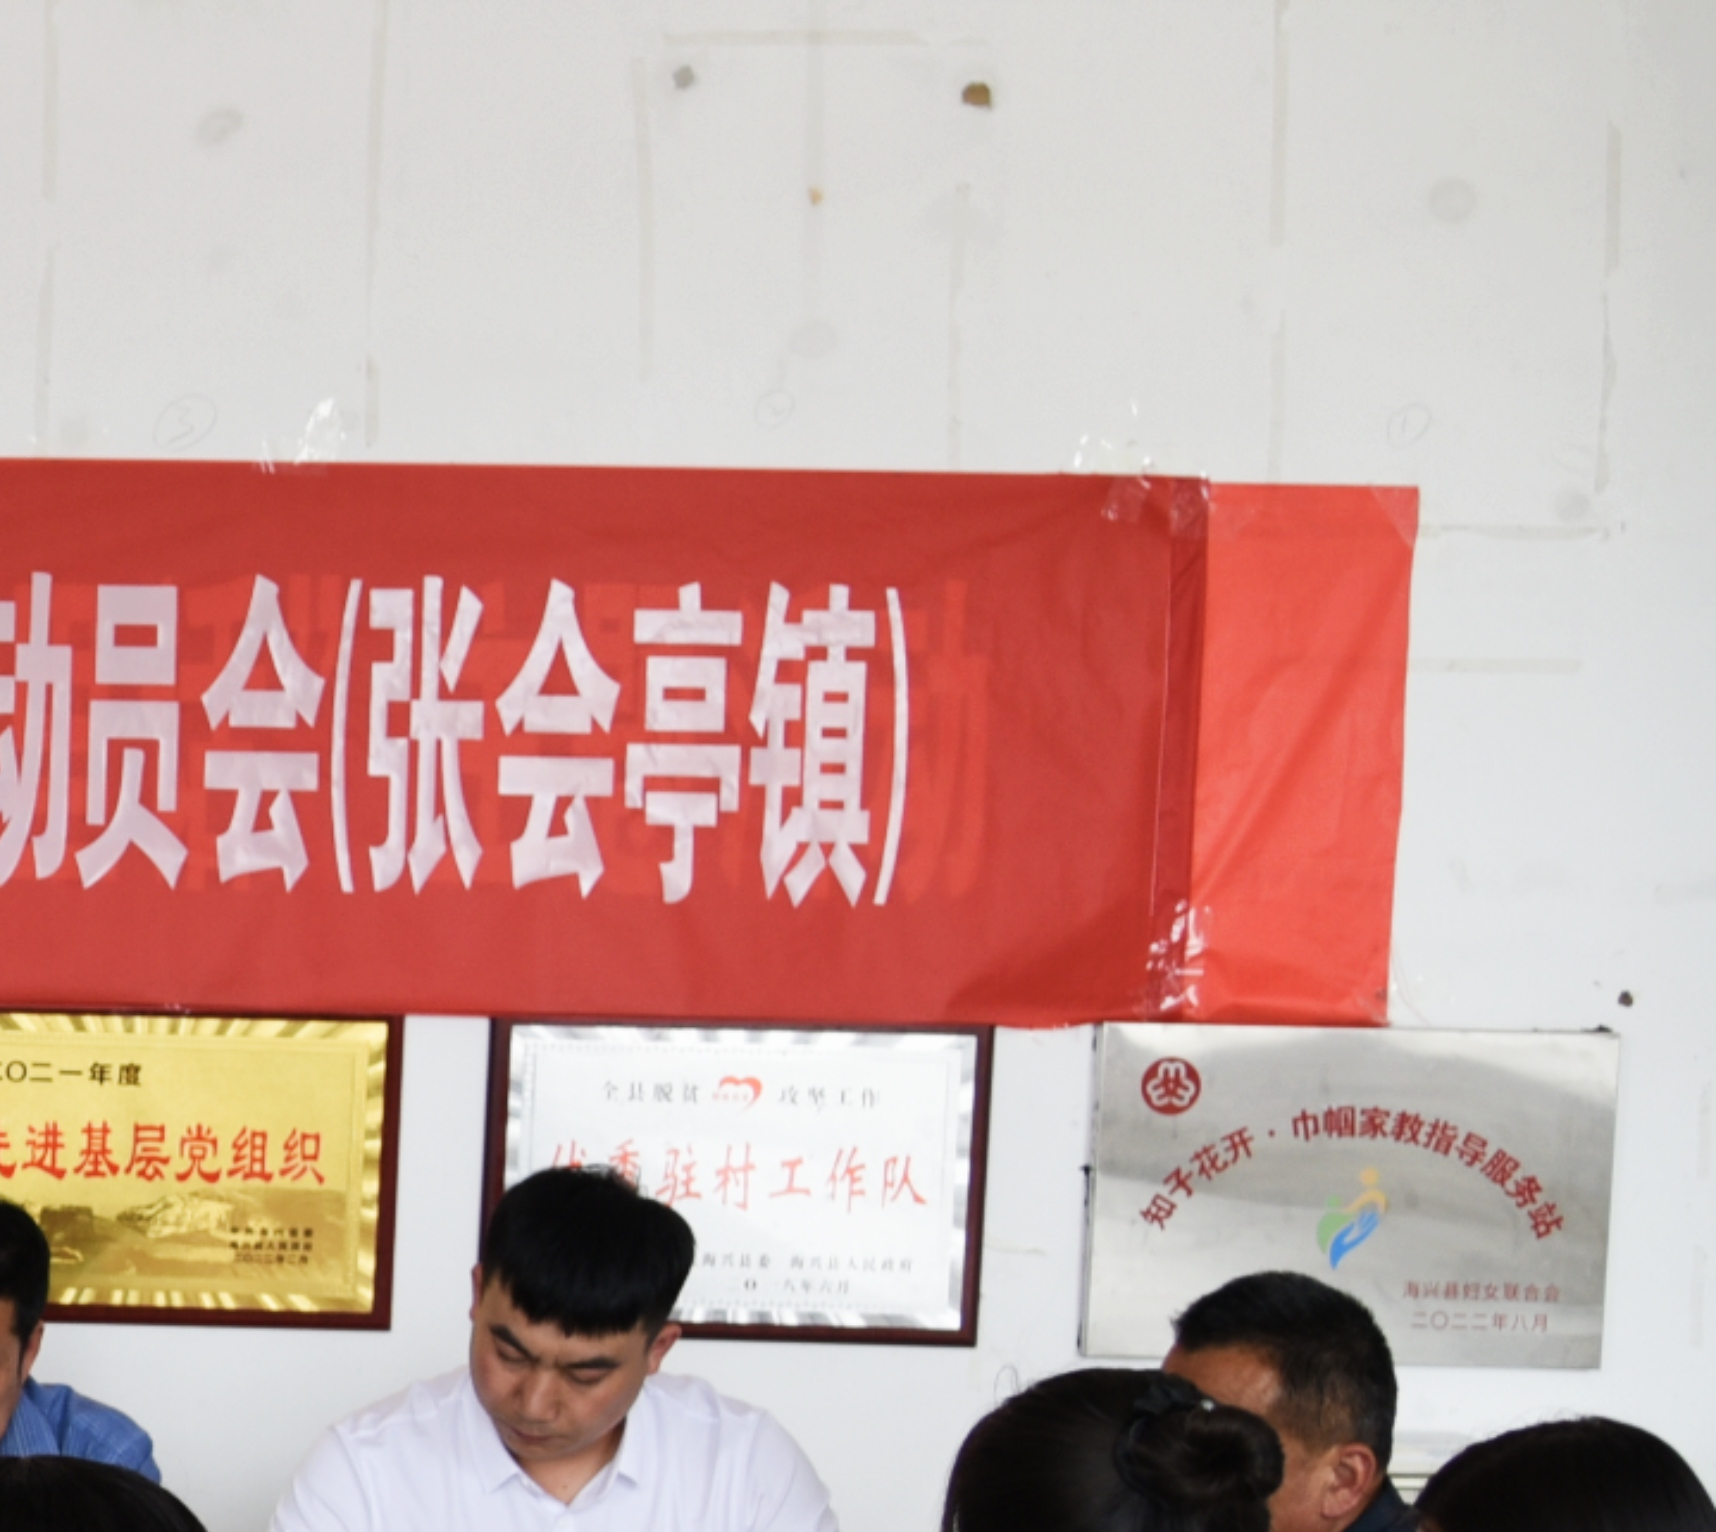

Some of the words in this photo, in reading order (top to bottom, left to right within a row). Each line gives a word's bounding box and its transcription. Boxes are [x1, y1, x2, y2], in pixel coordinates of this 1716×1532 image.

[603, 1080, 699, 1104] 全县脱贫
[779, 1085, 880, 1111] 攻坚工作
[1402, 1280, 1562, 1302] 海兴县妇女联合会
